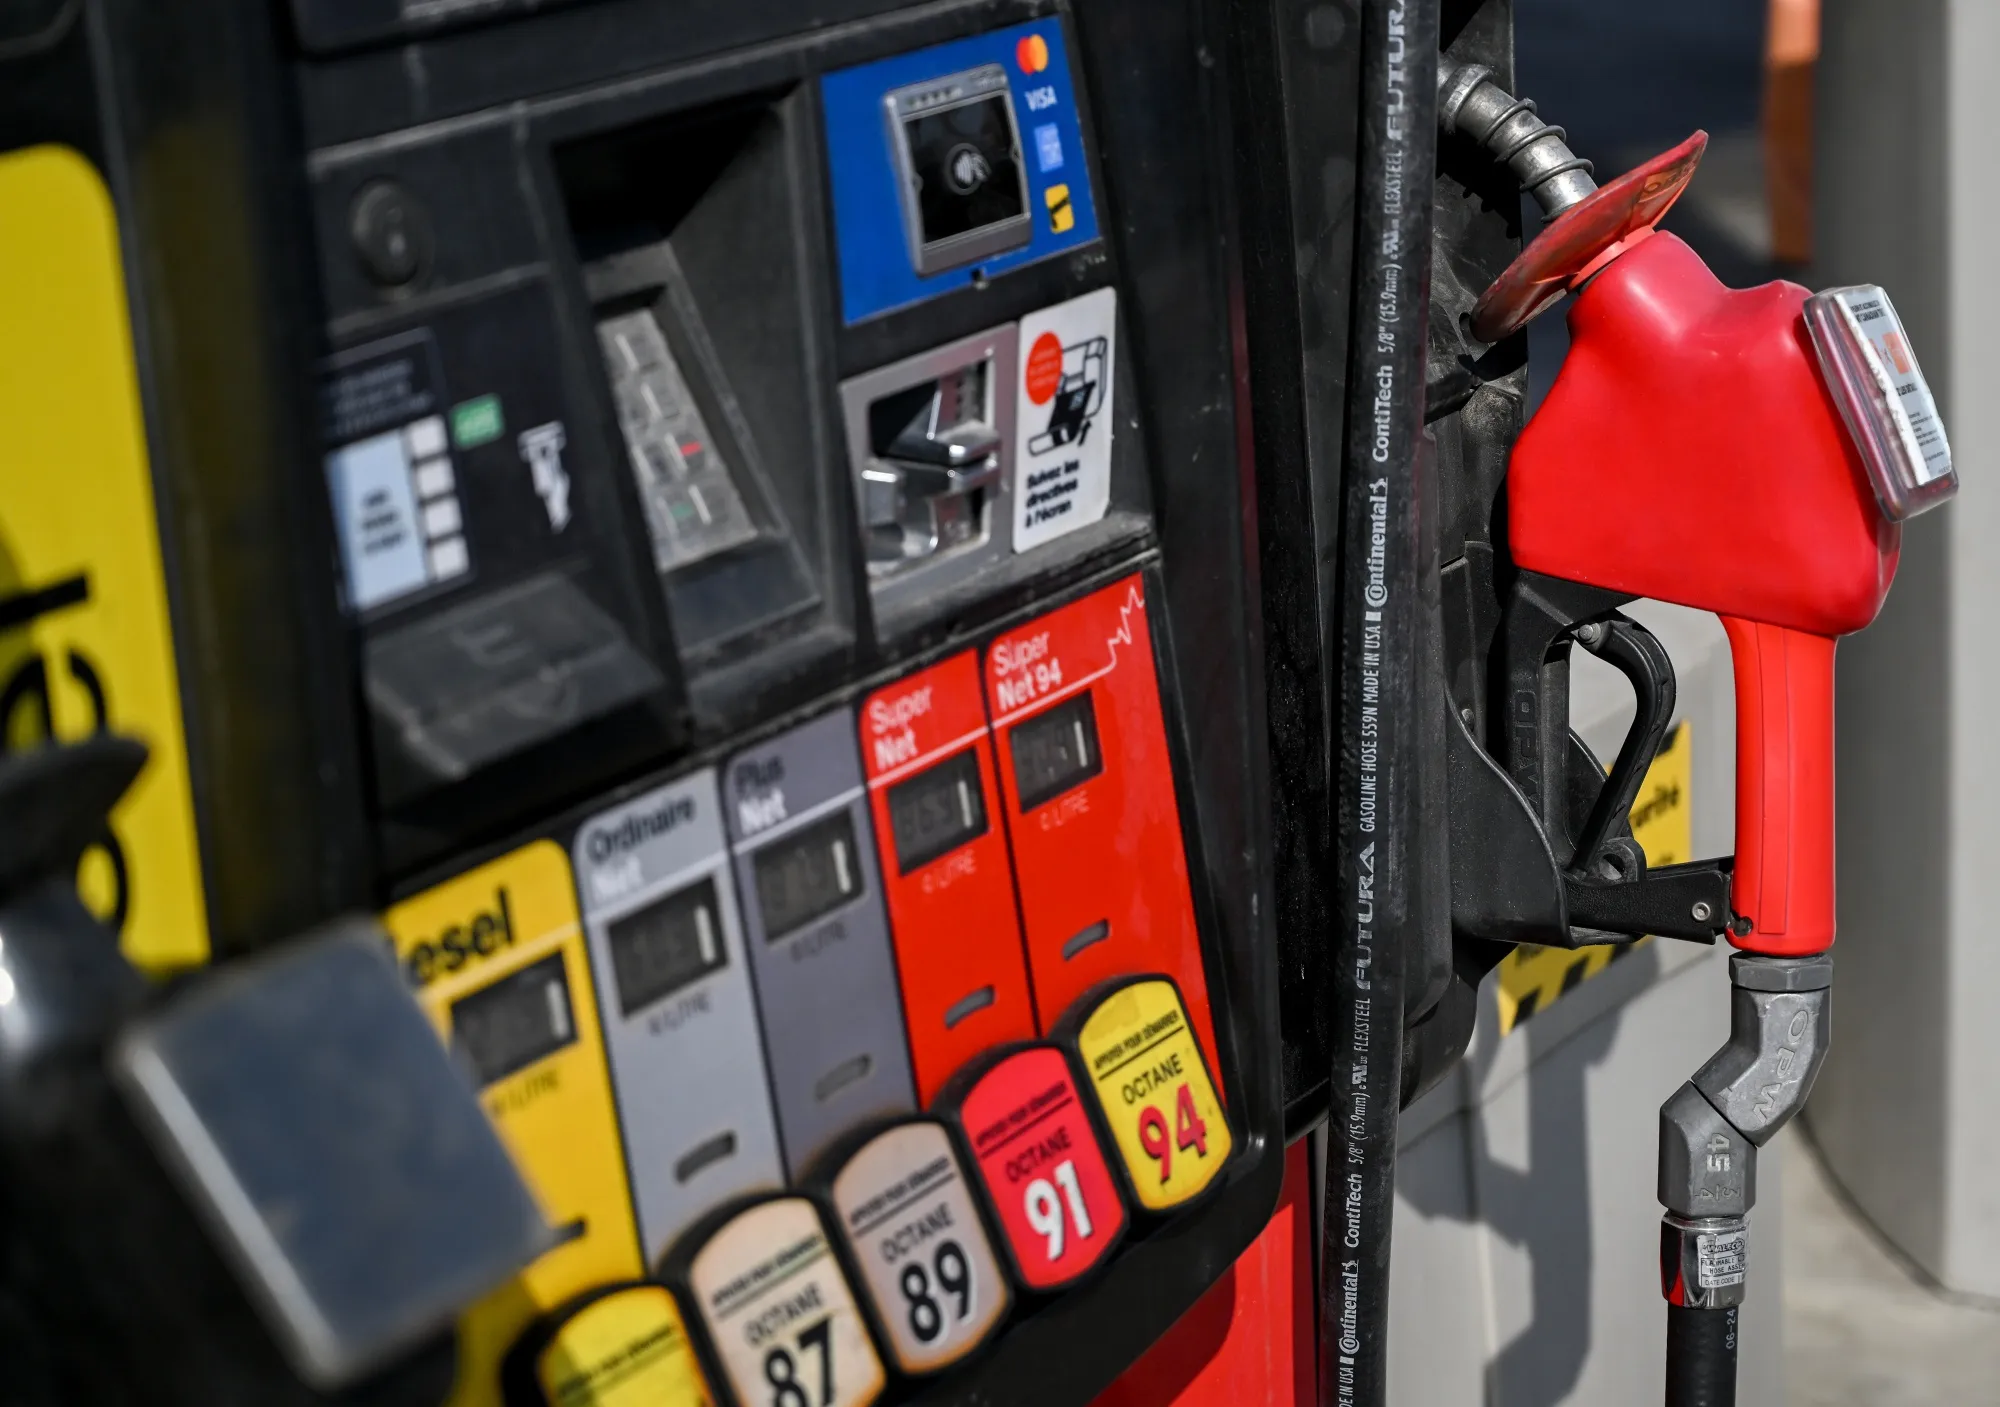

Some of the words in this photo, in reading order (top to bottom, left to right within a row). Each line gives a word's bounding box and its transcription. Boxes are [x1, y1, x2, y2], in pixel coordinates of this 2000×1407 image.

[1387, 0, 1405, 140] FUTUR
[1024, 86, 1058, 112] VISA
[1384, 150, 1402, 214] FLEXSTEEL
[1379, 263, 1402, 323] (15.9mm)
[1377, 326, 1396, 353] 5/8"
[1372, 365, 1394, 463] ContiTech
[1364, 494, 1388, 608] Continental
[992, 630, 1051, 676] Super
[1363, 653, 1380, 666] IN
[1365, 625, 1381, 649] USA
[869, 682, 934, 734] Super
[996, 672, 1033, 711] Net
[1034, 658, 1063, 694] 94
[1363, 669, 1380, 703] MADE
[1361, 706, 1378, 737] 559N
[734, 752, 784, 796] Plus
[875, 731, 918, 770] Net
[1361, 741, 1377, 772] HOSE
[587, 794, 697, 864] Ordinaire
[738, 790, 788, 835] Net
[1360, 774, 1376, 833] GASOLINE
[590, 858, 644, 901] Net
[405, 882, 515, 989] esel
[1356, 841, 1375, 990] FUTURA
[1353, 998, 1371, 1052] FLEXSTEEL
[1121, 1052, 1184, 1106] OCTANE
[1753, 1009, 1809, 1124] OPW
[1137, 1081, 1207, 1186] 94
[1349, 1092, 1371, 1141] (15.9mm)
[1004, 1126, 1072, 1184] OCTANE
[1348, 1142, 1365, 1165] 5/8"
[1706, 1132, 1731, 1172] 45
[880, 1203, 956, 1264] OCTANE
[1023, 1159, 1094, 1262] 91
[1344, 1173, 1363, 1248] ContiTech
[1701, 1257, 1736, 1267] FLAMABLE
[1709, 1266, 1725, 1275] HOSE
[1720, 1277, 1735, 1285] CODE
[743, 1281, 826, 1349] OCTANE
[899, 1239, 973, 1345] 89
[1338, 1272, 1360, 1355] Continental
[1725, 1309, 1736, 1350] 06-24
[762, 1319, 833, 1407] 87
[1339, 1367, 1354, 1386] USA
[1339, 1386, 1354, 1397] IN
